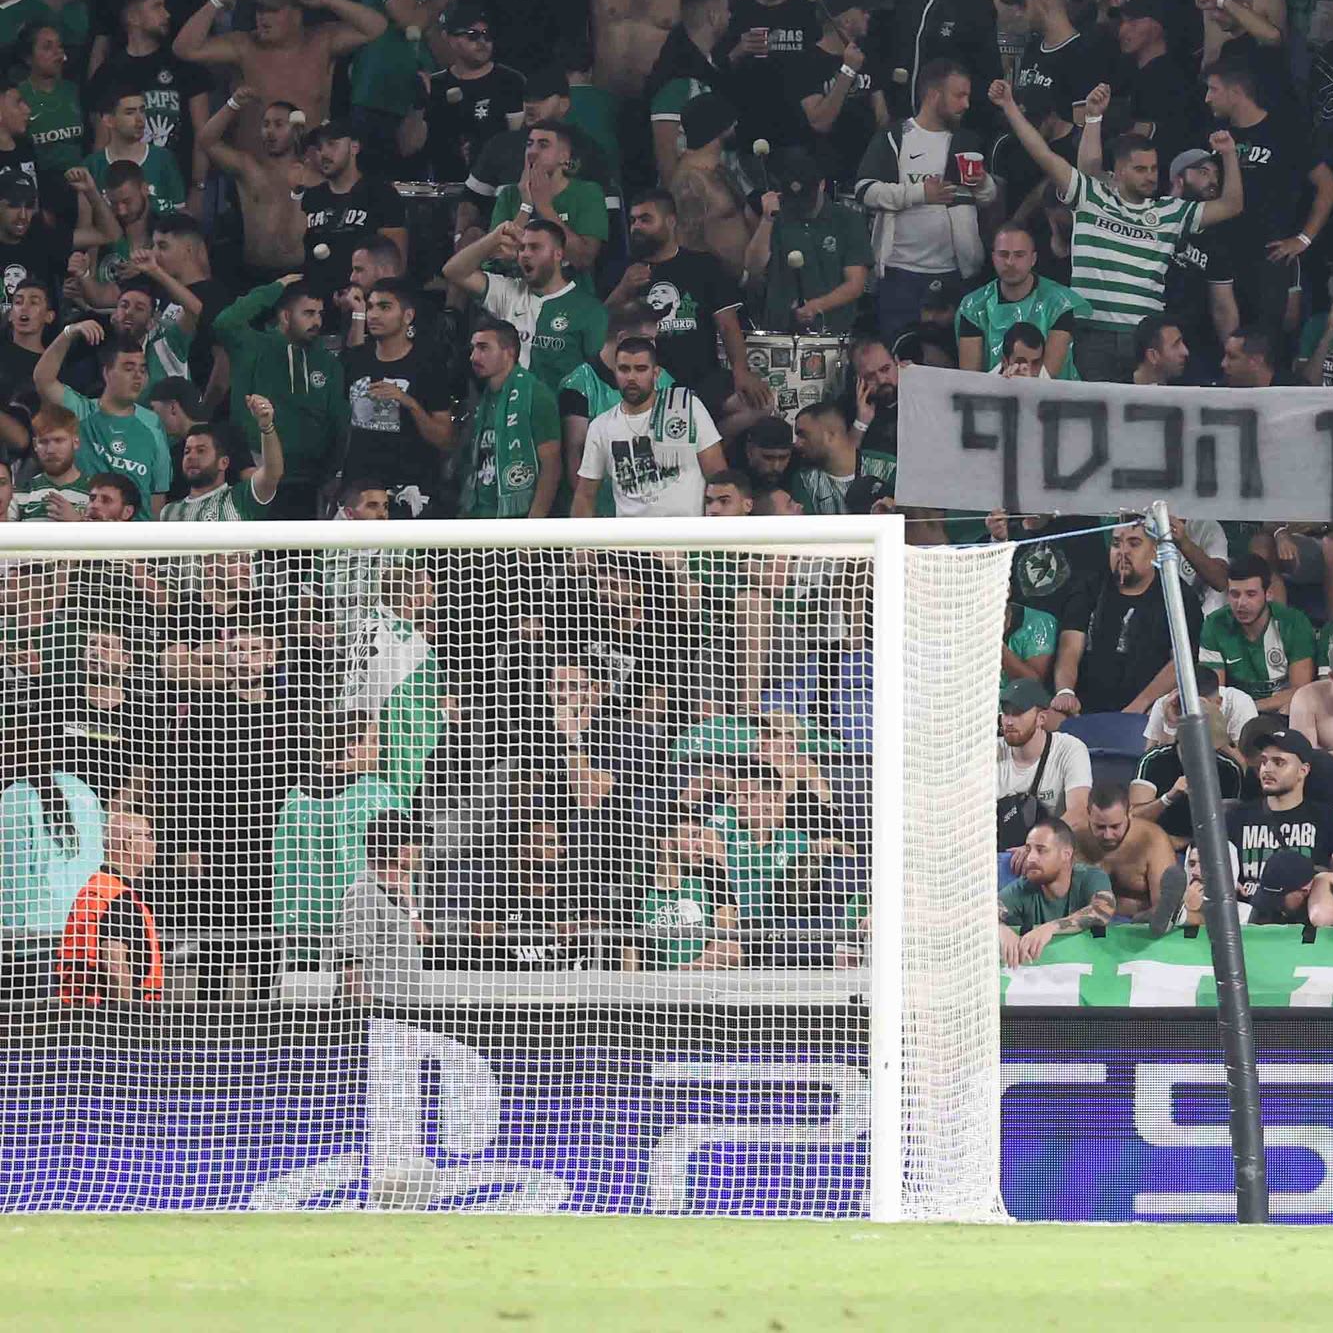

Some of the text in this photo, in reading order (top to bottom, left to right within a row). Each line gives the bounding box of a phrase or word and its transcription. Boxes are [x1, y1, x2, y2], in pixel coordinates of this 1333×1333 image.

[31, 125, 82, 144] HOND
[1248, 145, 1273, 164] 02
[345, 209, 368, 226] 02
[1096, 217, 1158, 241] HONDA
[518, 330, 566, 349] OLVO
[950, 392, 1267, 515] הכסף
[1242, 823, 1316, 851] MACCABI
